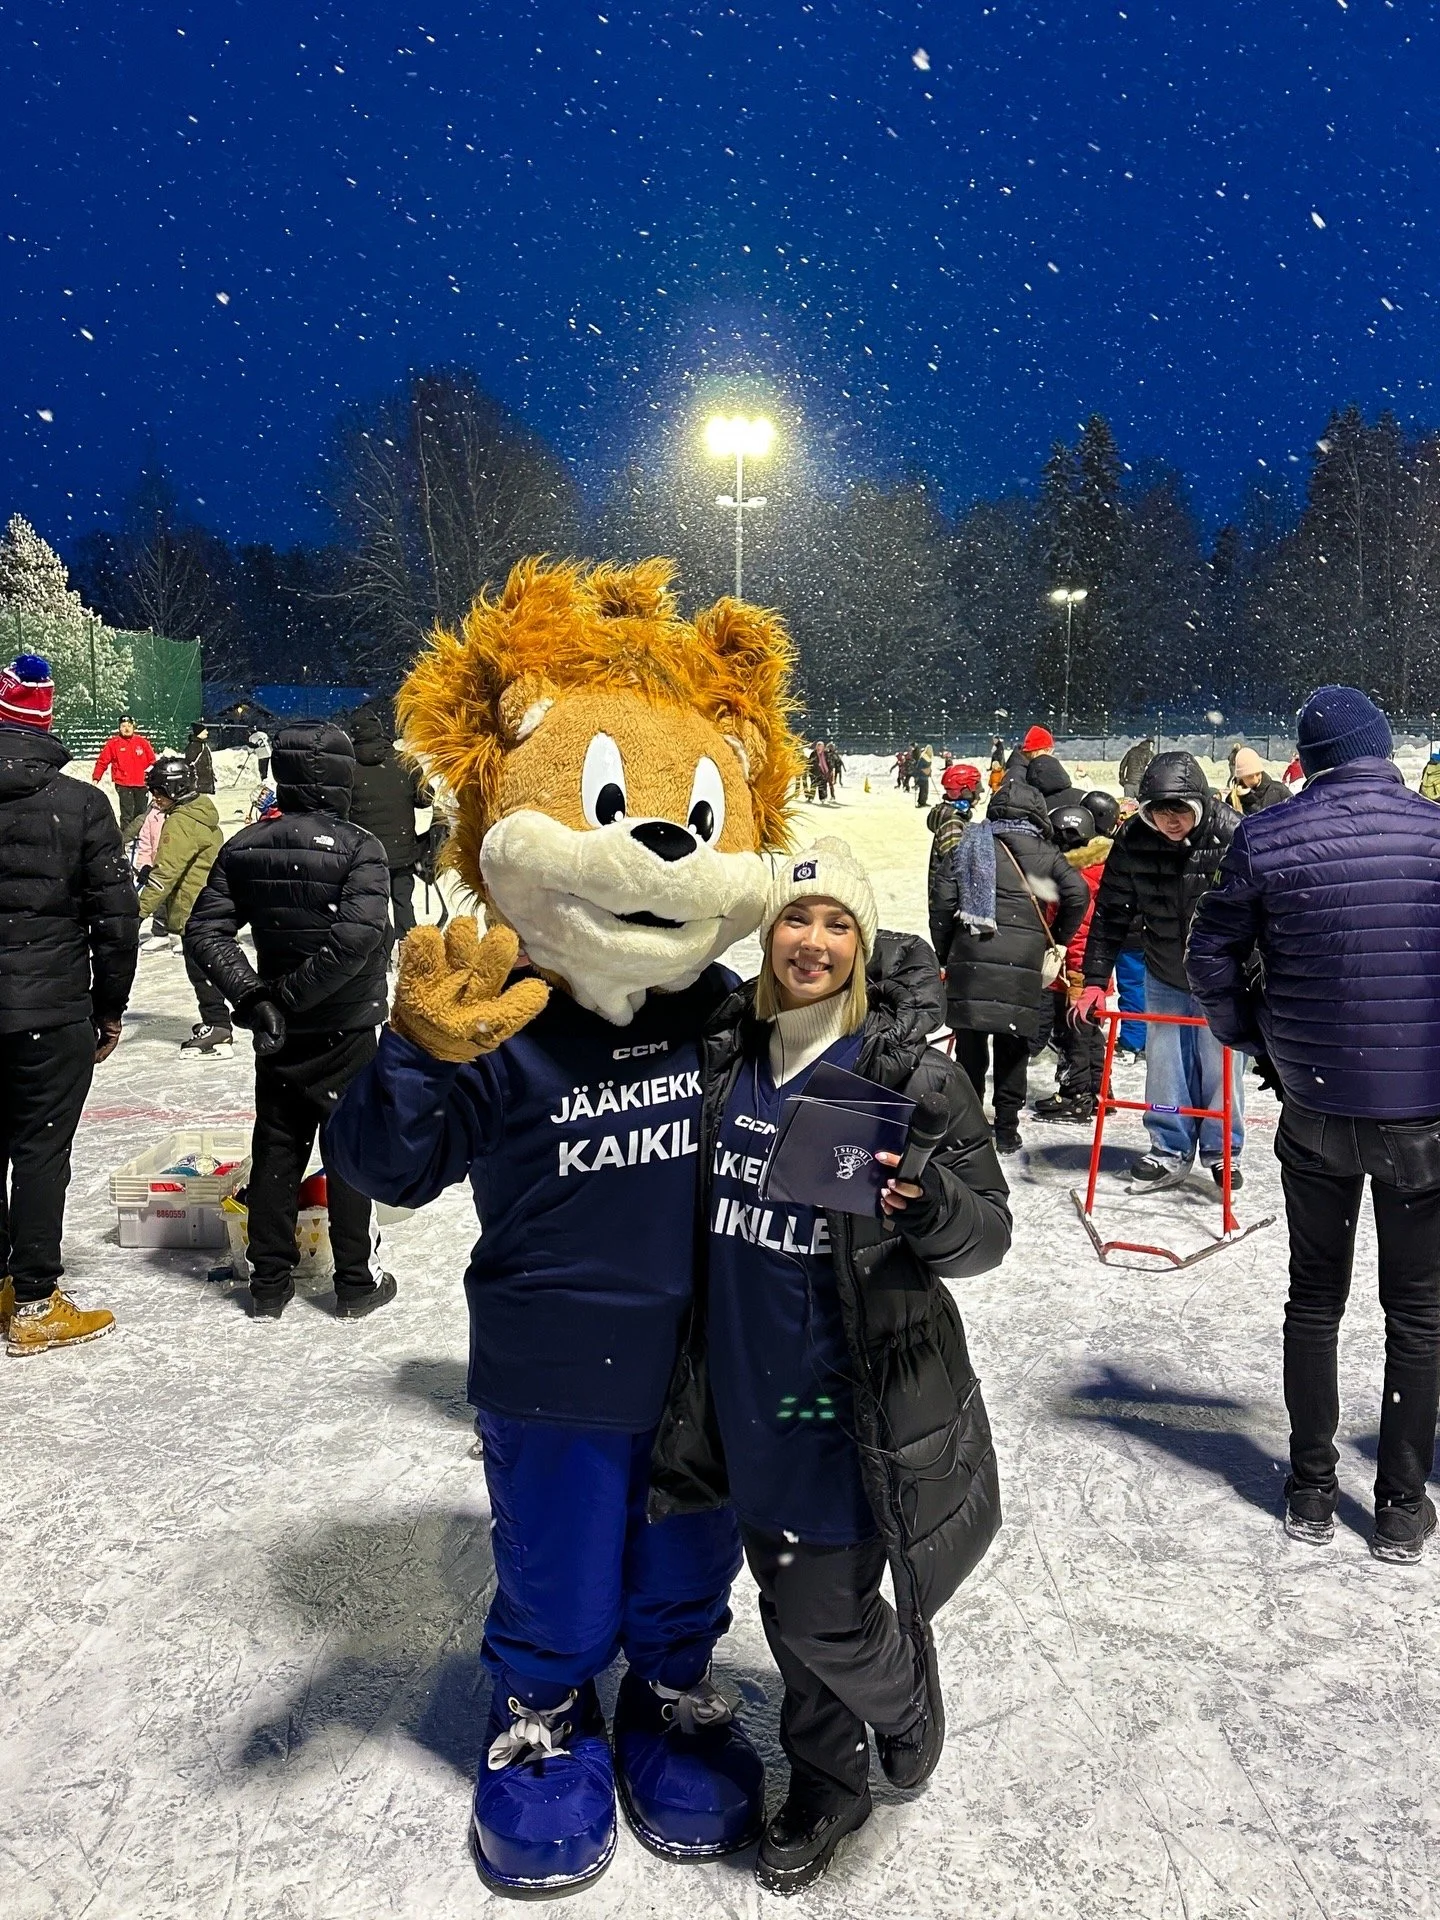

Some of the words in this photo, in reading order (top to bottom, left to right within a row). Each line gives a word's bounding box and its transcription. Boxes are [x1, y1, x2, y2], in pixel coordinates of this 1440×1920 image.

[612, 1041, 668, 1060] CCM
[550, 1070, 703, 1124] JÄÄKIEKK
[558, 1118, 698, 1177] KAIKIL
[840, 1147, 868, 1160] SUOMI
[710, 1197, 833, 1255] IKILLE
